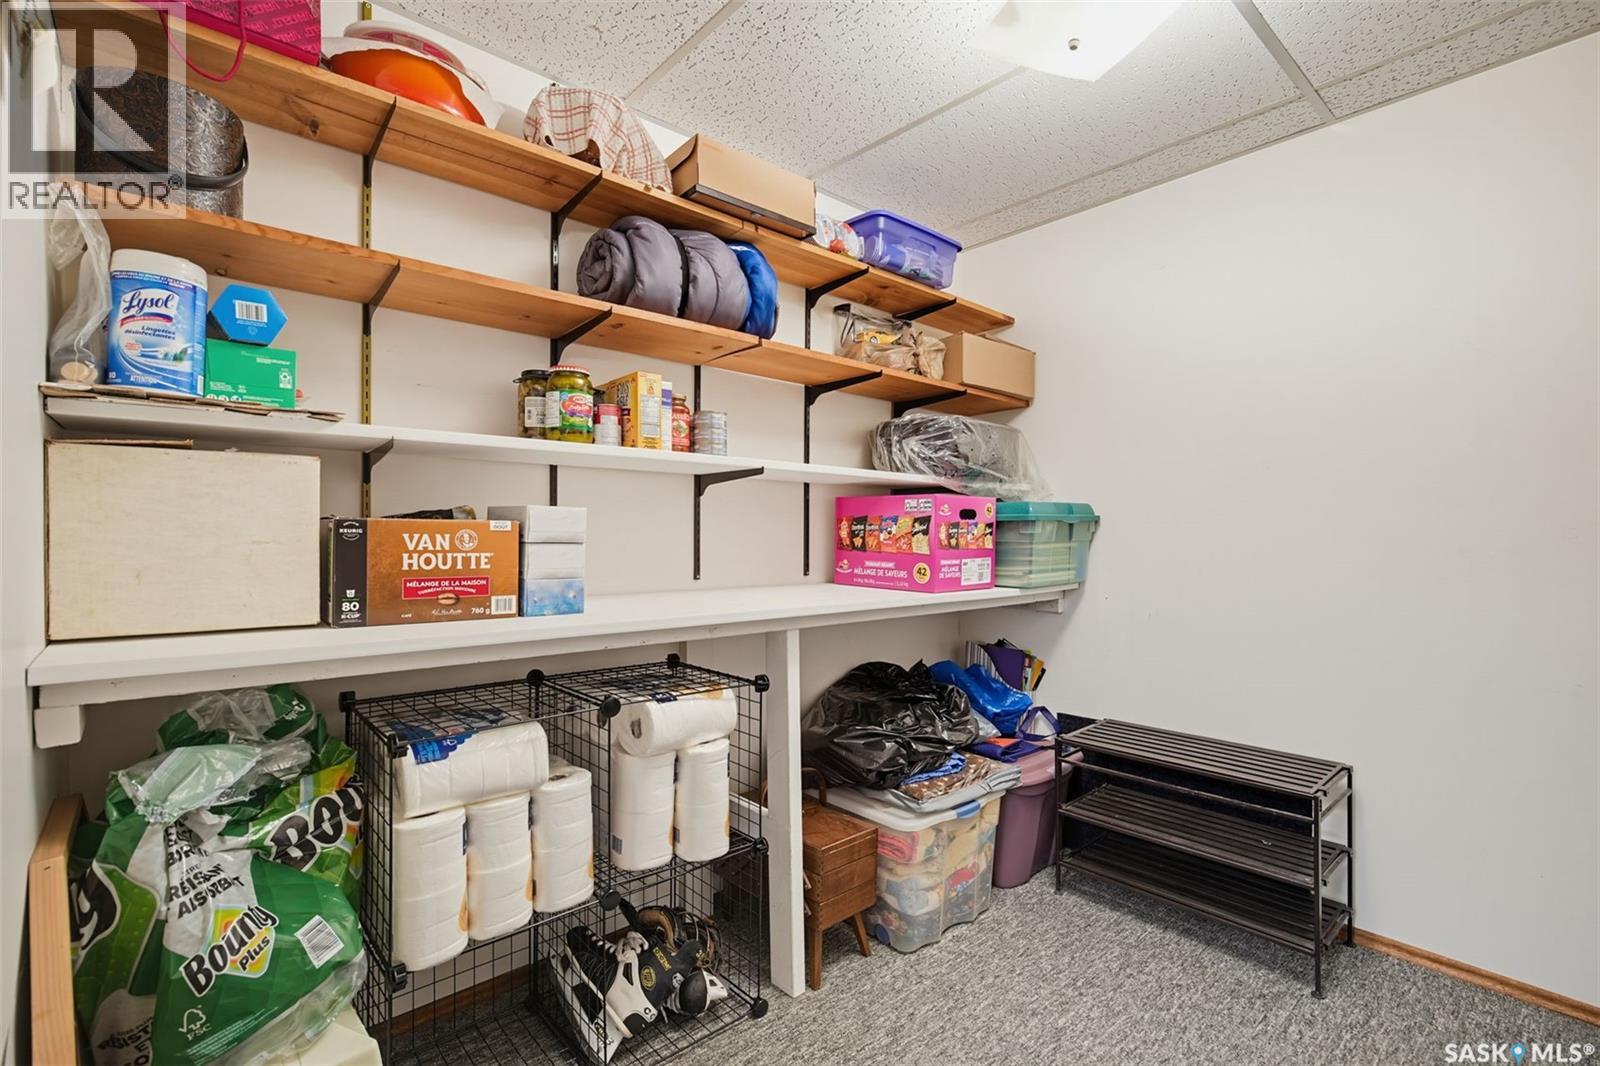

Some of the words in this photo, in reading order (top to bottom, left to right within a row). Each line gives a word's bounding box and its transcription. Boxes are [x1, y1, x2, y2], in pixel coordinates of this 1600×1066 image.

[122, 290, 175, 315] Lysol
[141, 325, 176, 335] Lingettes
[402, 533, 451, 550] VAN
[401, 553, 492, 570] HOUTTE
[853, 567, 877, 576] MÉLANGE
[884, 569, 908, 578] SAVEURS
[916, 567, 927, 576] 42
[341, 602, 360, 611] 80
